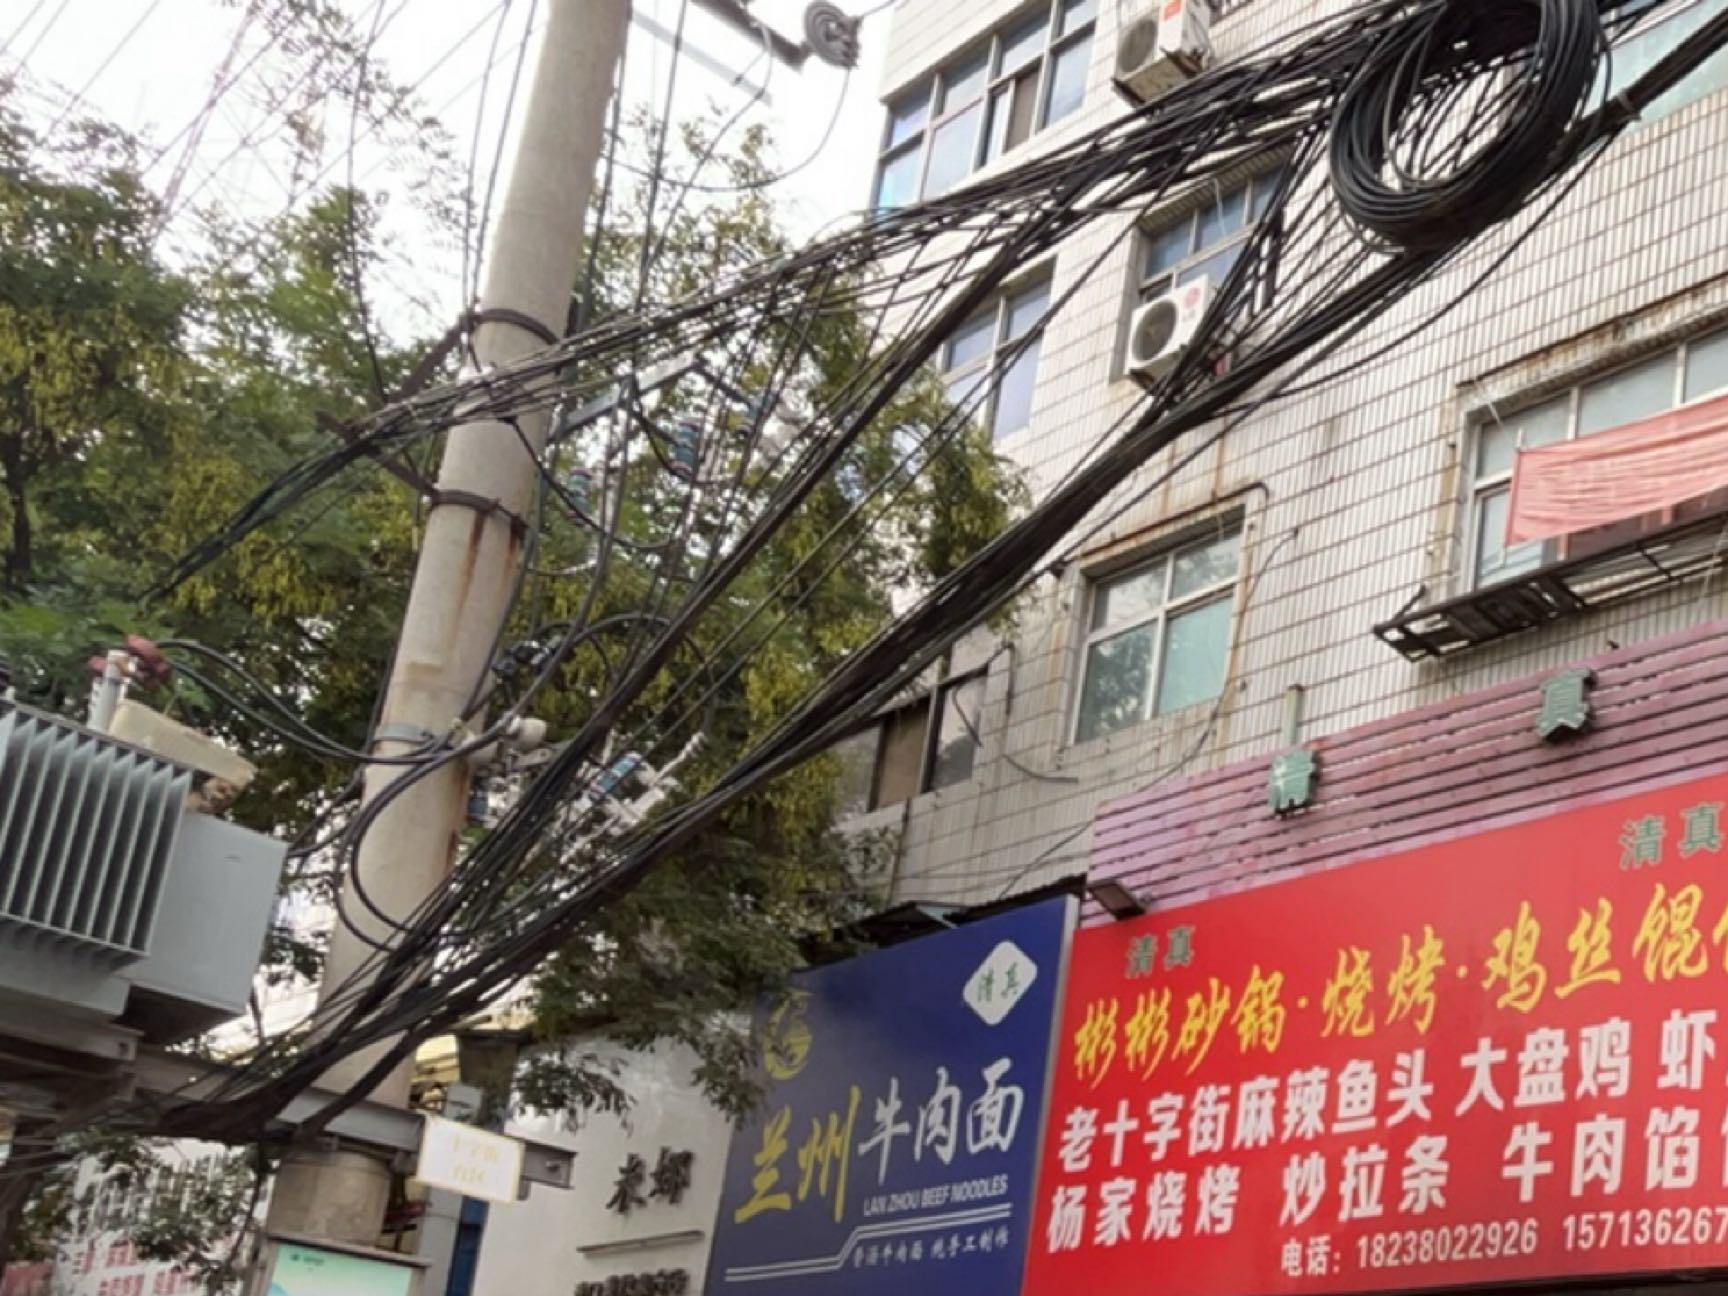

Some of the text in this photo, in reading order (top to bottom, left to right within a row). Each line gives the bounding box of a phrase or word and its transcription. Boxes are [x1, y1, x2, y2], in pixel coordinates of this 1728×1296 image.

[1619, 801, 1724, 869] 清真
[1125, 924, 1194, 979] 清真
[1059, 1052, 1434, 1173] 老十字街麻辣鱼头
[1456, 1016, 1629, 1119] 大盘鸡
[734, 1057, 1024, 1225] 兰州牛肉面
[921, 1184, 950, 1209] BEEF
[951, 1174, 1008, 1204] NOODLES
[1046, 1168, 1240, 1253] 杨家烧烤
[1280, 1133, 1450, 1229] 炒拉条
[1357, 1216, 1539, 1270] 18238022926
